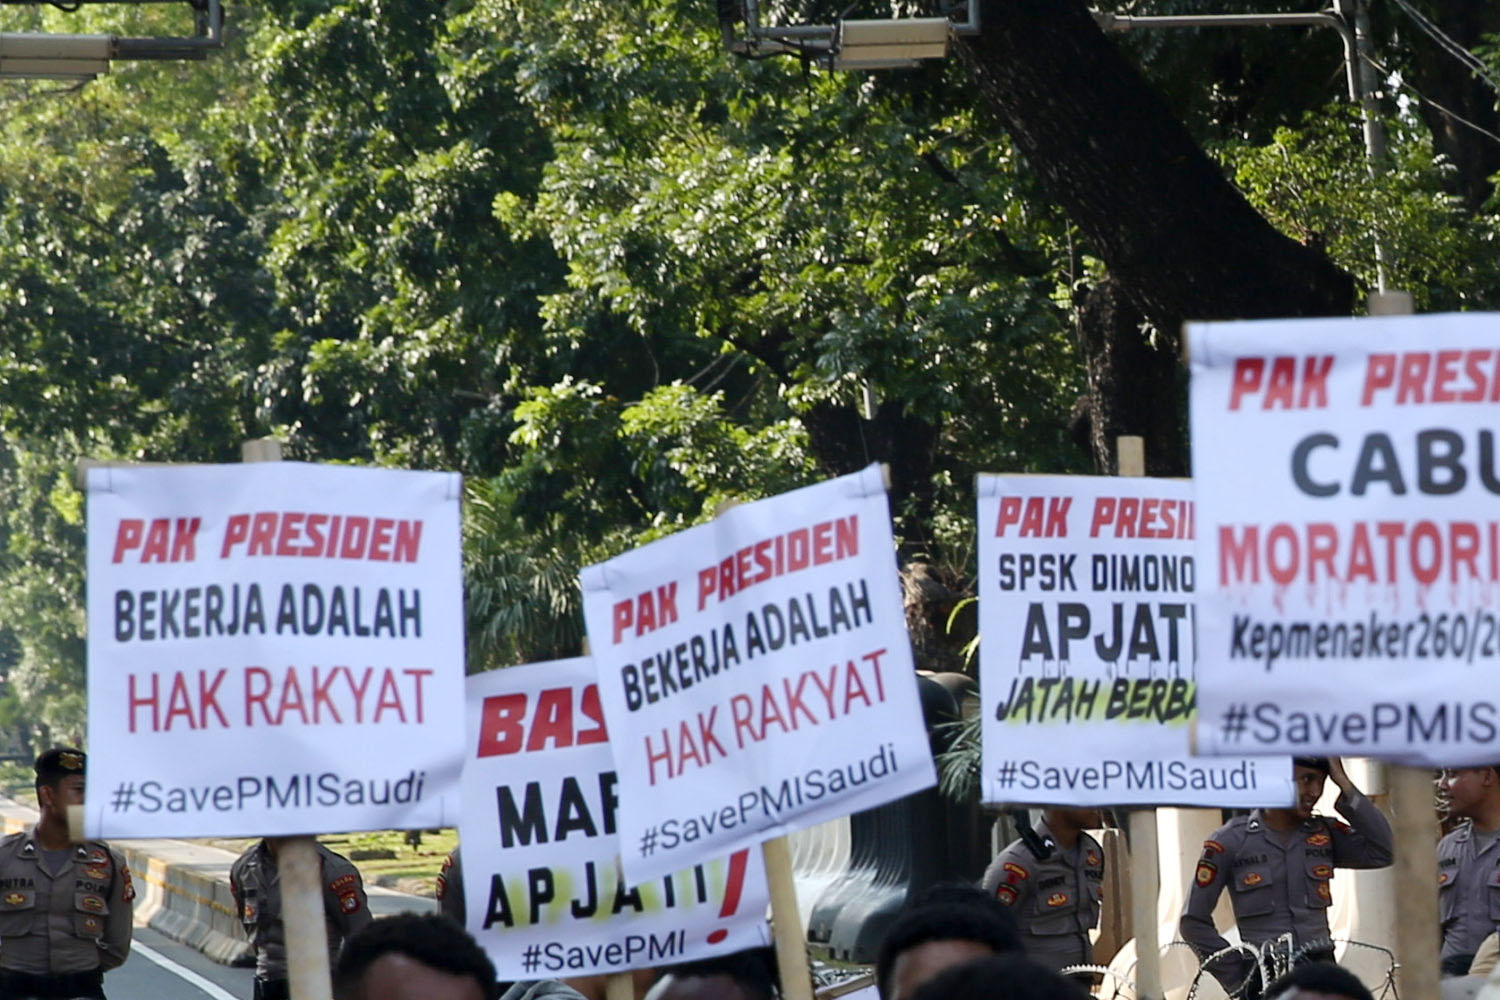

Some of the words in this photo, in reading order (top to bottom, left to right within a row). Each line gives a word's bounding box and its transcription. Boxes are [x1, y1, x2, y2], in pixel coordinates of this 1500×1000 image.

[1228, 356, 1334, 411] PAK
[112, 517, 202, 564] PAK
[221, 512, 424, 563] PRESIDEN
[994, 496, 1072, 539] PAK
[1089, 496, 1194, 540] PRESI
[612, 580, 679, 645] PAK
[697, 514, 861, 612] PRESIDEN
[999, 554, 1076, 593] SPSK
[114, 583, 268, 643] BEKERJA
[275, 584, 423, 640] ADALAH
[621, 623, 743, 712] BEKERJA
[744, 577, 873, 658] ADALAH
[126, 668, 231, 734] HAK
[243, 665, 434, 727] RAKYAT
[644, 704, 728, 786] HAK
[729, 647, 892, 750] RAKYAT
[996, 677, 1099, 724] JATAH
[112, 770, 427, 814] #SavePMISaudi
[639, 743, 899, 858] #SavePMISaudi
[999, 760, 1257, 791] #SavePMISaudi
[522, 929, 686, 973] #SavePMI
